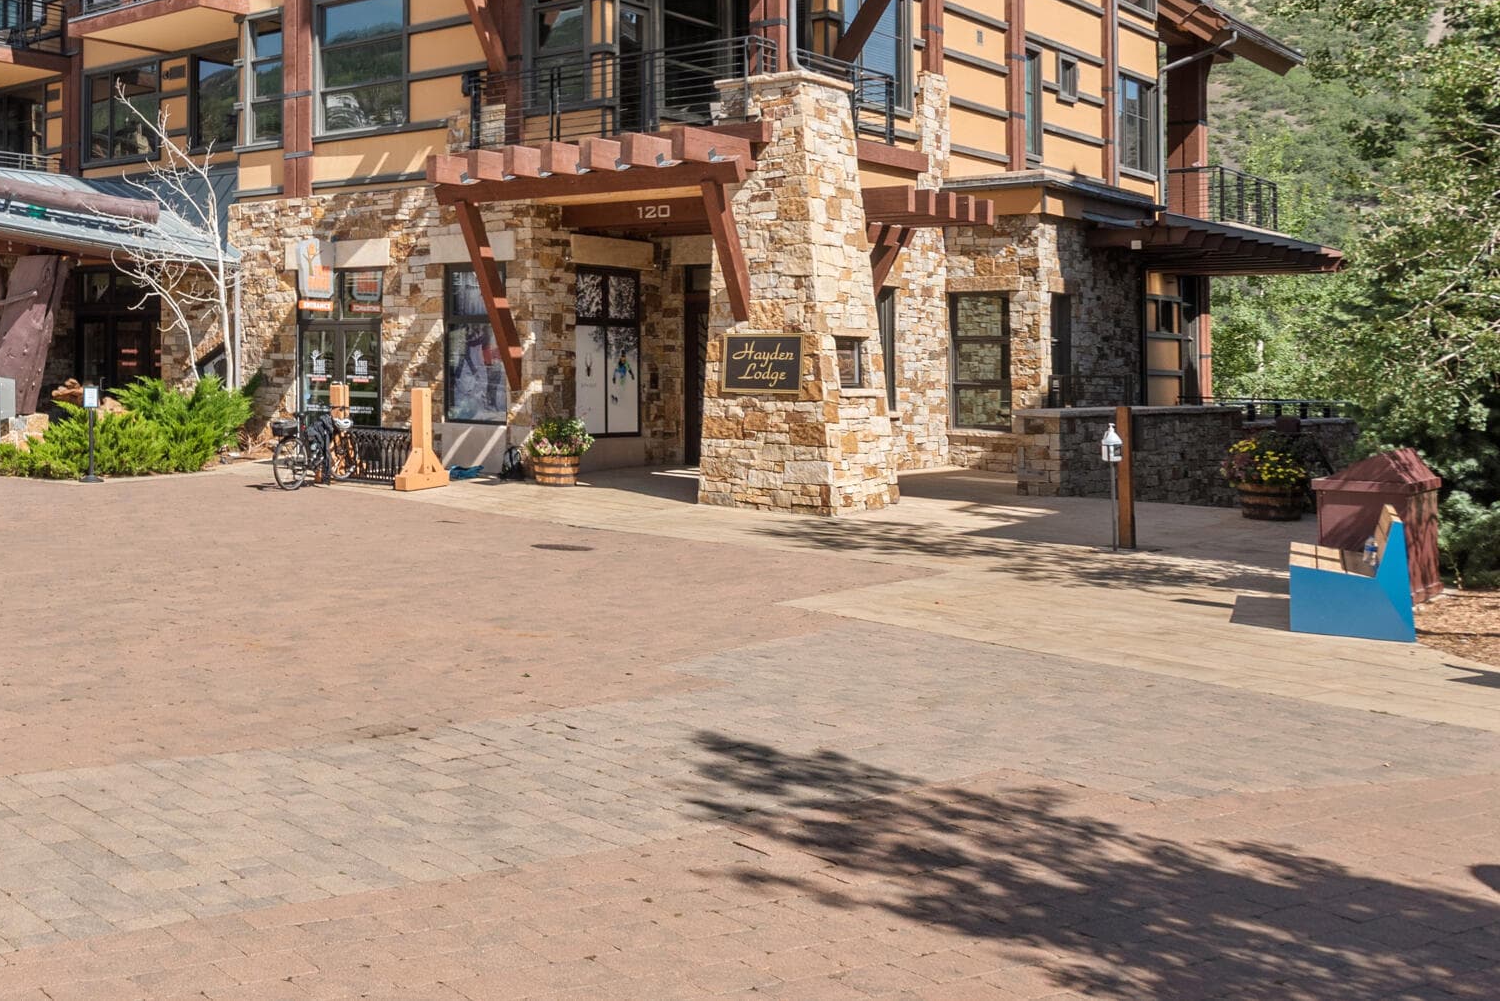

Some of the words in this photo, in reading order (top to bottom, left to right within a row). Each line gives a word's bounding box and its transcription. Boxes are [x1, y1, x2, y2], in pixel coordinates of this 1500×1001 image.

[637, 205, 670, 219] 120
[732, 340, 795, 367] Hayden
[737, 362, 787, 388] Lodge
